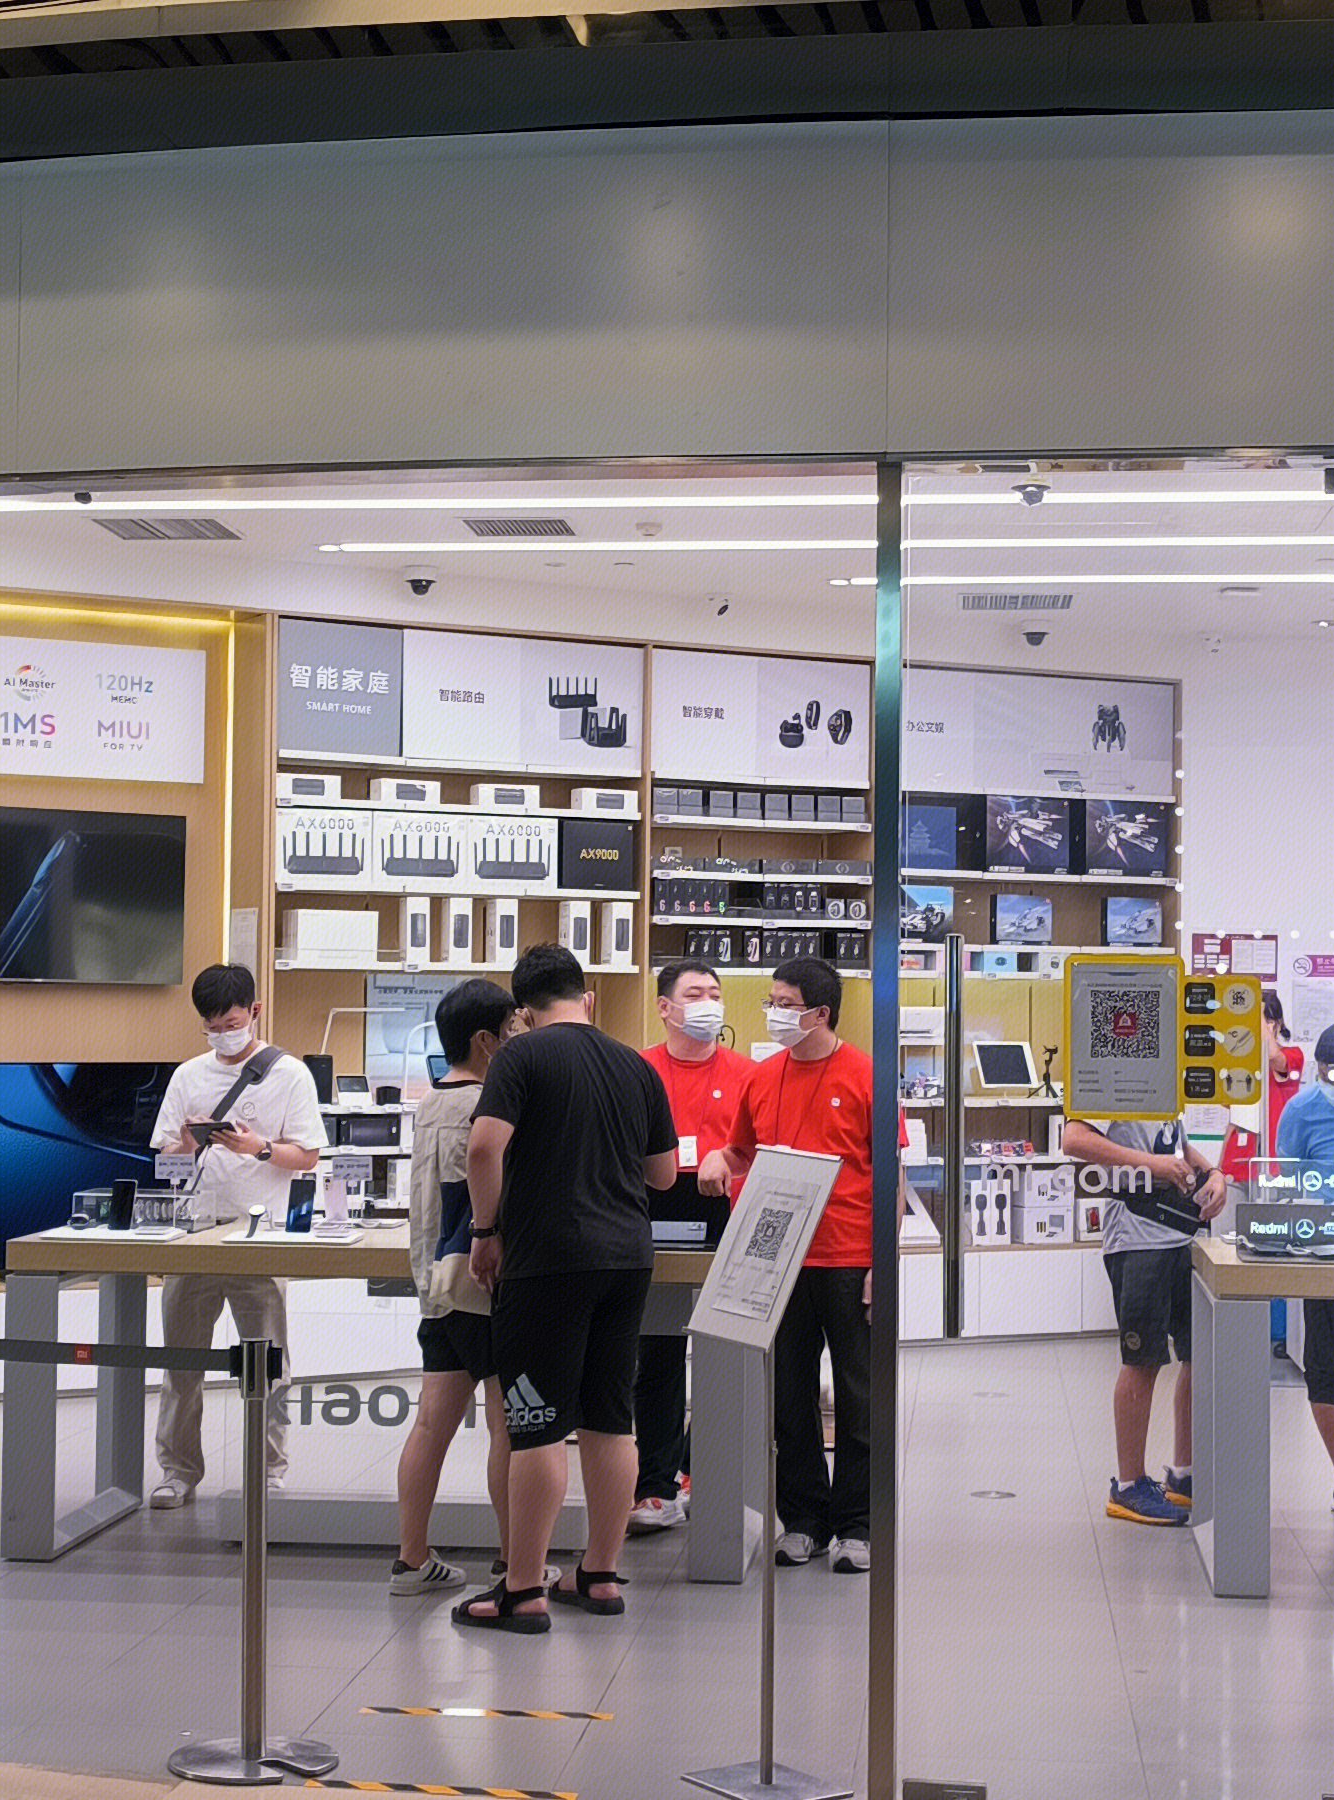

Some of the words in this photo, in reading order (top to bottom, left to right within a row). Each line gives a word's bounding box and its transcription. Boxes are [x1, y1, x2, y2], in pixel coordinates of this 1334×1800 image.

[18, 678, 57, 691] Master
[95, 672, 154, 694] 120Hz
[289, 662, 391, 695] 智能家庭
[438, 689, 485, 704] 智能路由
[305, 701, 340, 713] SMART
[342, 703, 372, 715] HOME
[0, 711, 56, 736] 1MS
[96, 718, 150, 741] MIUI
[295, 816, 355, 831] AX6000
[392, 819, 451, 833] AX6000
[486, 823, 542, 837] AX6000
[579, 848, 619, 861] AX9000
[1249, 1221, 1288, 1235] Redmi
